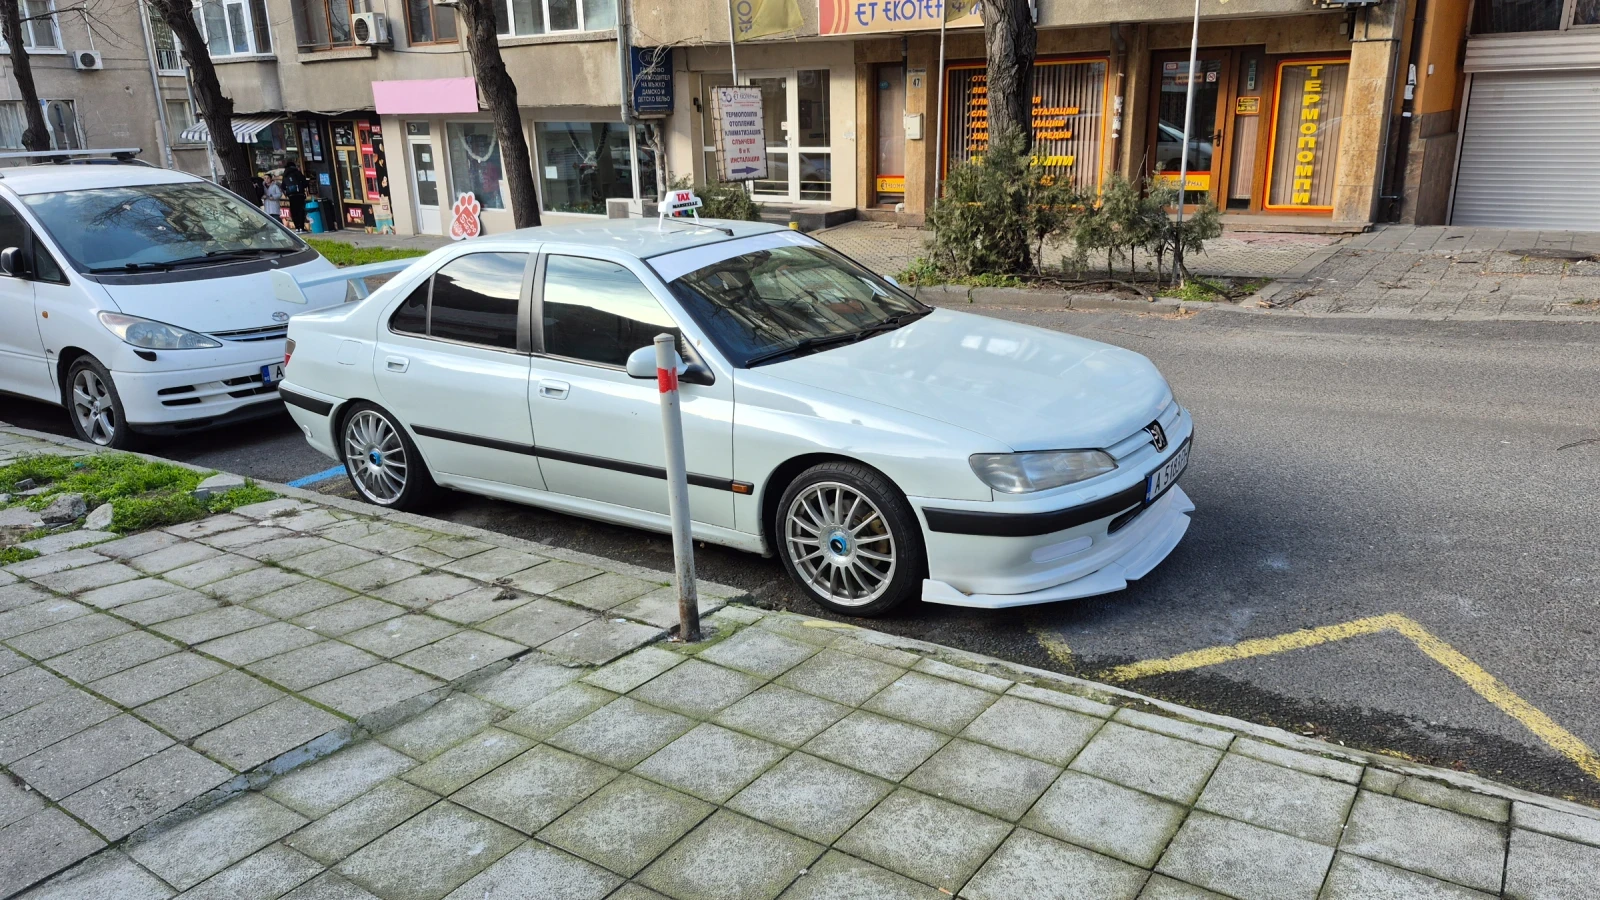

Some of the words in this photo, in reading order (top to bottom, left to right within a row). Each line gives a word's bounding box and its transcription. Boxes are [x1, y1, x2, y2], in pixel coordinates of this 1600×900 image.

[855, 3, 878, 26] ЕТ
[913, 78, 920, 87] 47
[971, 98, 988, 106] КЛИ
[1032, 107, 1080, 116] СТАЛАЦИИ
[725, 129, 761, 137] КЛИМАТИЗАЦИЯ
[971, 132, 989, 140] ХИД
[1036, 131, 1073, 140] УРЕДБИ
[1291, 65, 1323, 204] ТЕРМОПОМПИ
[350, 208, 362, 217] ELIT
[1154, 472, 1160, 493] A
